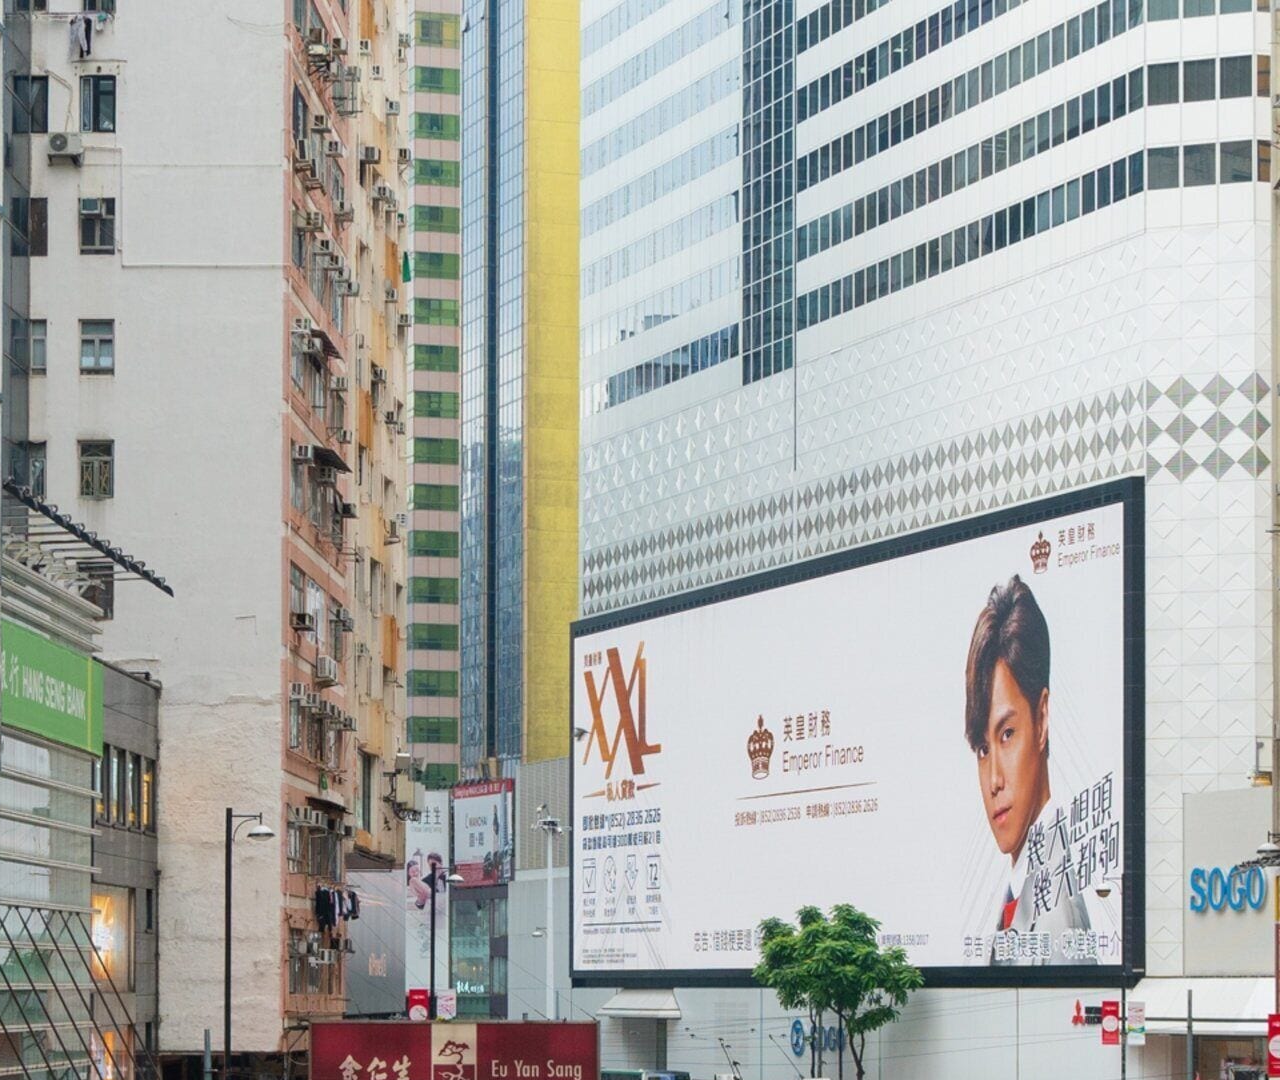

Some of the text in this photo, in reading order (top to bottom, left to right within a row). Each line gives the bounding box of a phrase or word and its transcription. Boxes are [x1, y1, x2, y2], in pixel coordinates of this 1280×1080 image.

[22, 664, 44, 704] HANG
[46, 674, 65, 713] SENG
[782, 709, 831, 742] 英皇財務
[782, 743, 864, 776] Emperor Finance
[1189, 865, 1265, 912] SOGO
[491, 1060, 507, 1078] Eu
[514, 1060, 539, 1078] Yan
